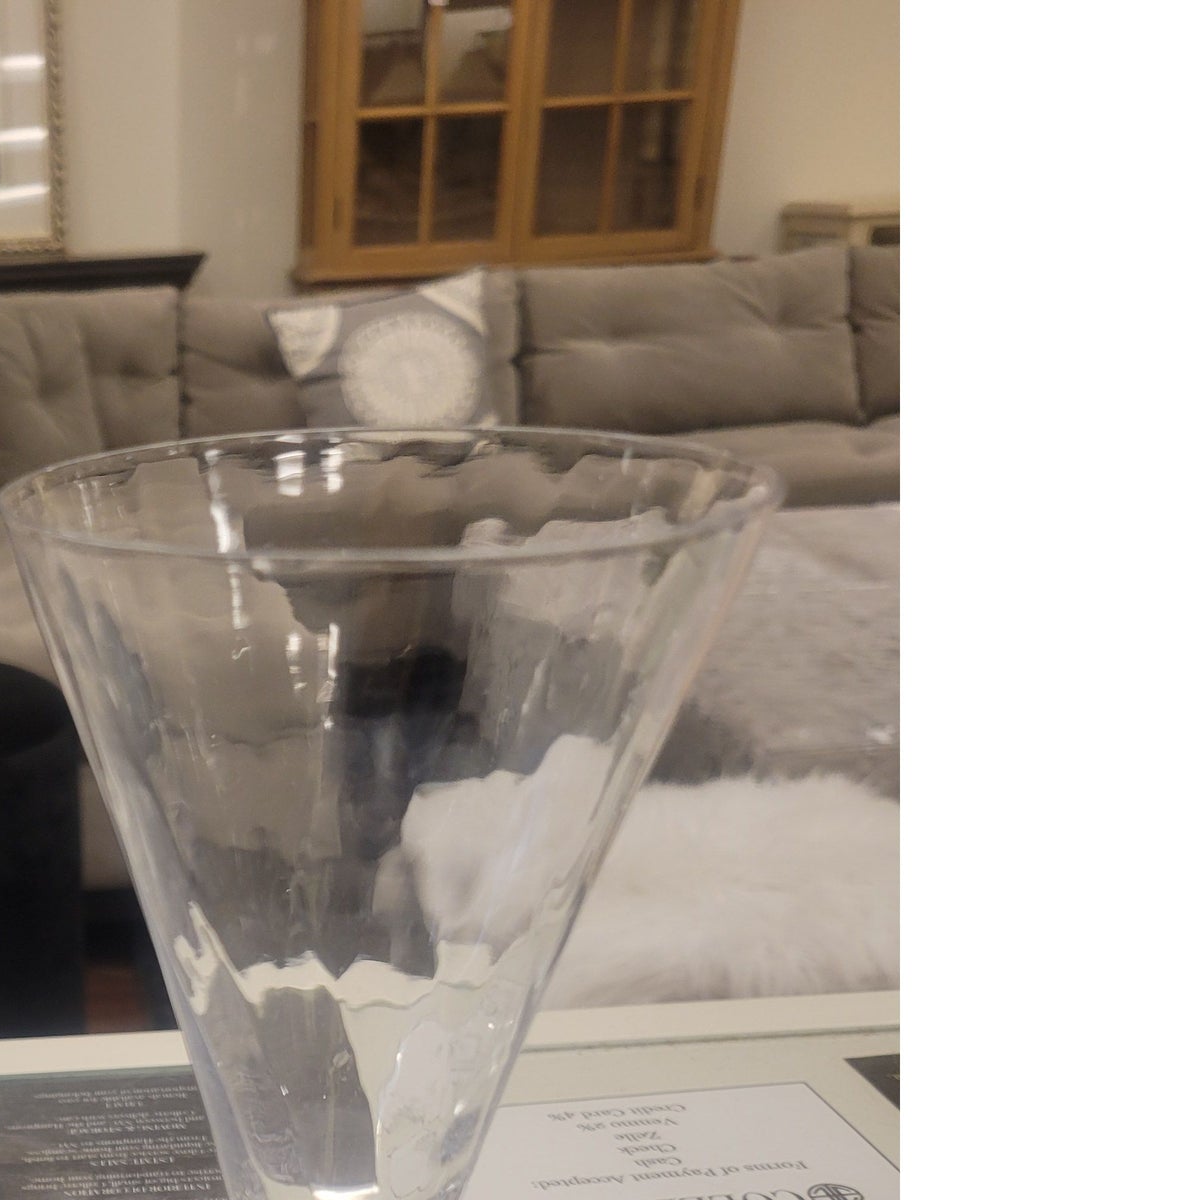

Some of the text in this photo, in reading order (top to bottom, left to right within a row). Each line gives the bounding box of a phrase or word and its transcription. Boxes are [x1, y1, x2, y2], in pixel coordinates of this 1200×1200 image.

[547, 1102, 687, 1122] Credit Card 4%
[138, 1123, 187, 1132] MOVING
[576, 1117, 679, 1133] Venmo 2%
[94, 1137, 154, 1146] Hamptons
[613, 1132, 661, 1144] Zelle
[616, 1142, 676, 1156] Check
[88, 1156, 174, 1166] ESTATE SALES
[634, 1156, 682, 1168] Cash
[531, 1160, 808, 1191] Forms of Payment Accepted:
[64, 1183, 211, 1197] INTERIOR DECORATION
